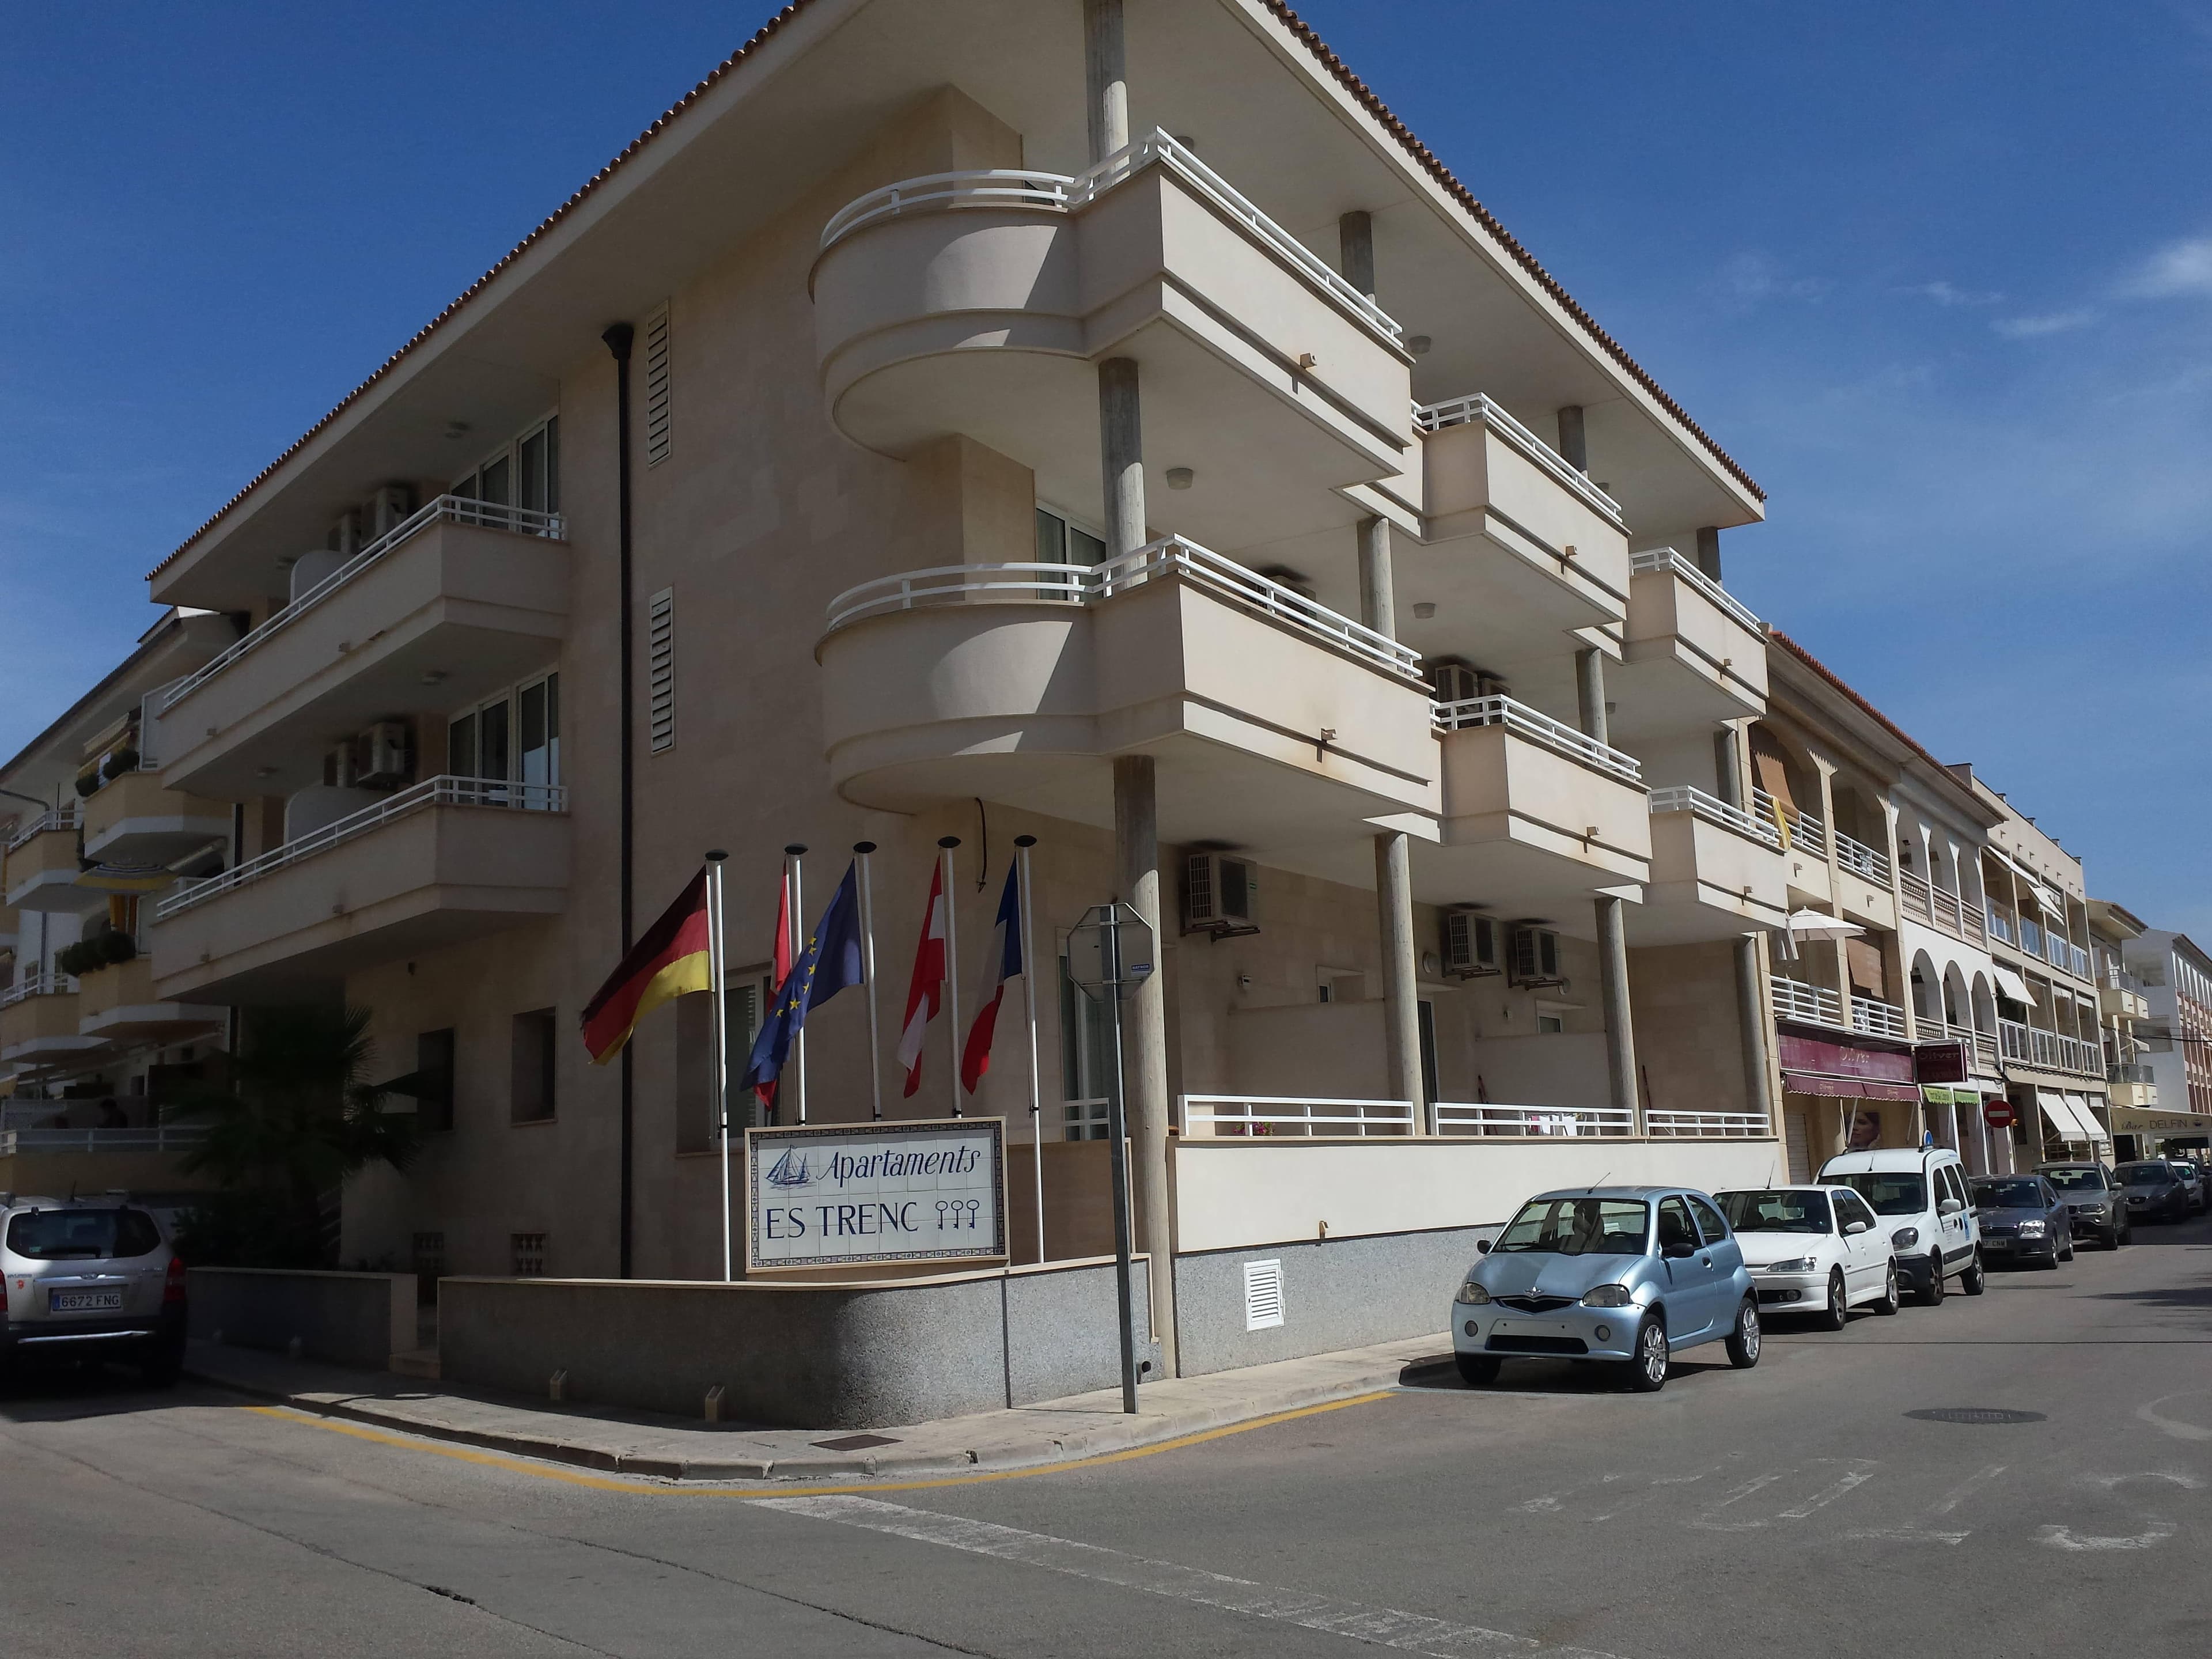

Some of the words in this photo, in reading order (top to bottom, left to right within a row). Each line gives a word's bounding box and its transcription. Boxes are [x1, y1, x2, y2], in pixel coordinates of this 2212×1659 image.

[2121, 1121, 2143, 1130] Bar
[2149, 1119, 2187, 1129] DELFIN
[816, 1145, 981, 1188] Apartaments
[766, 1208, 806, 1240] ES
[816, 1202, 919, 1237] TRENC
[62, 1296, 93, 1307] 6672
[96, 1295, 119, 1305] FNG
